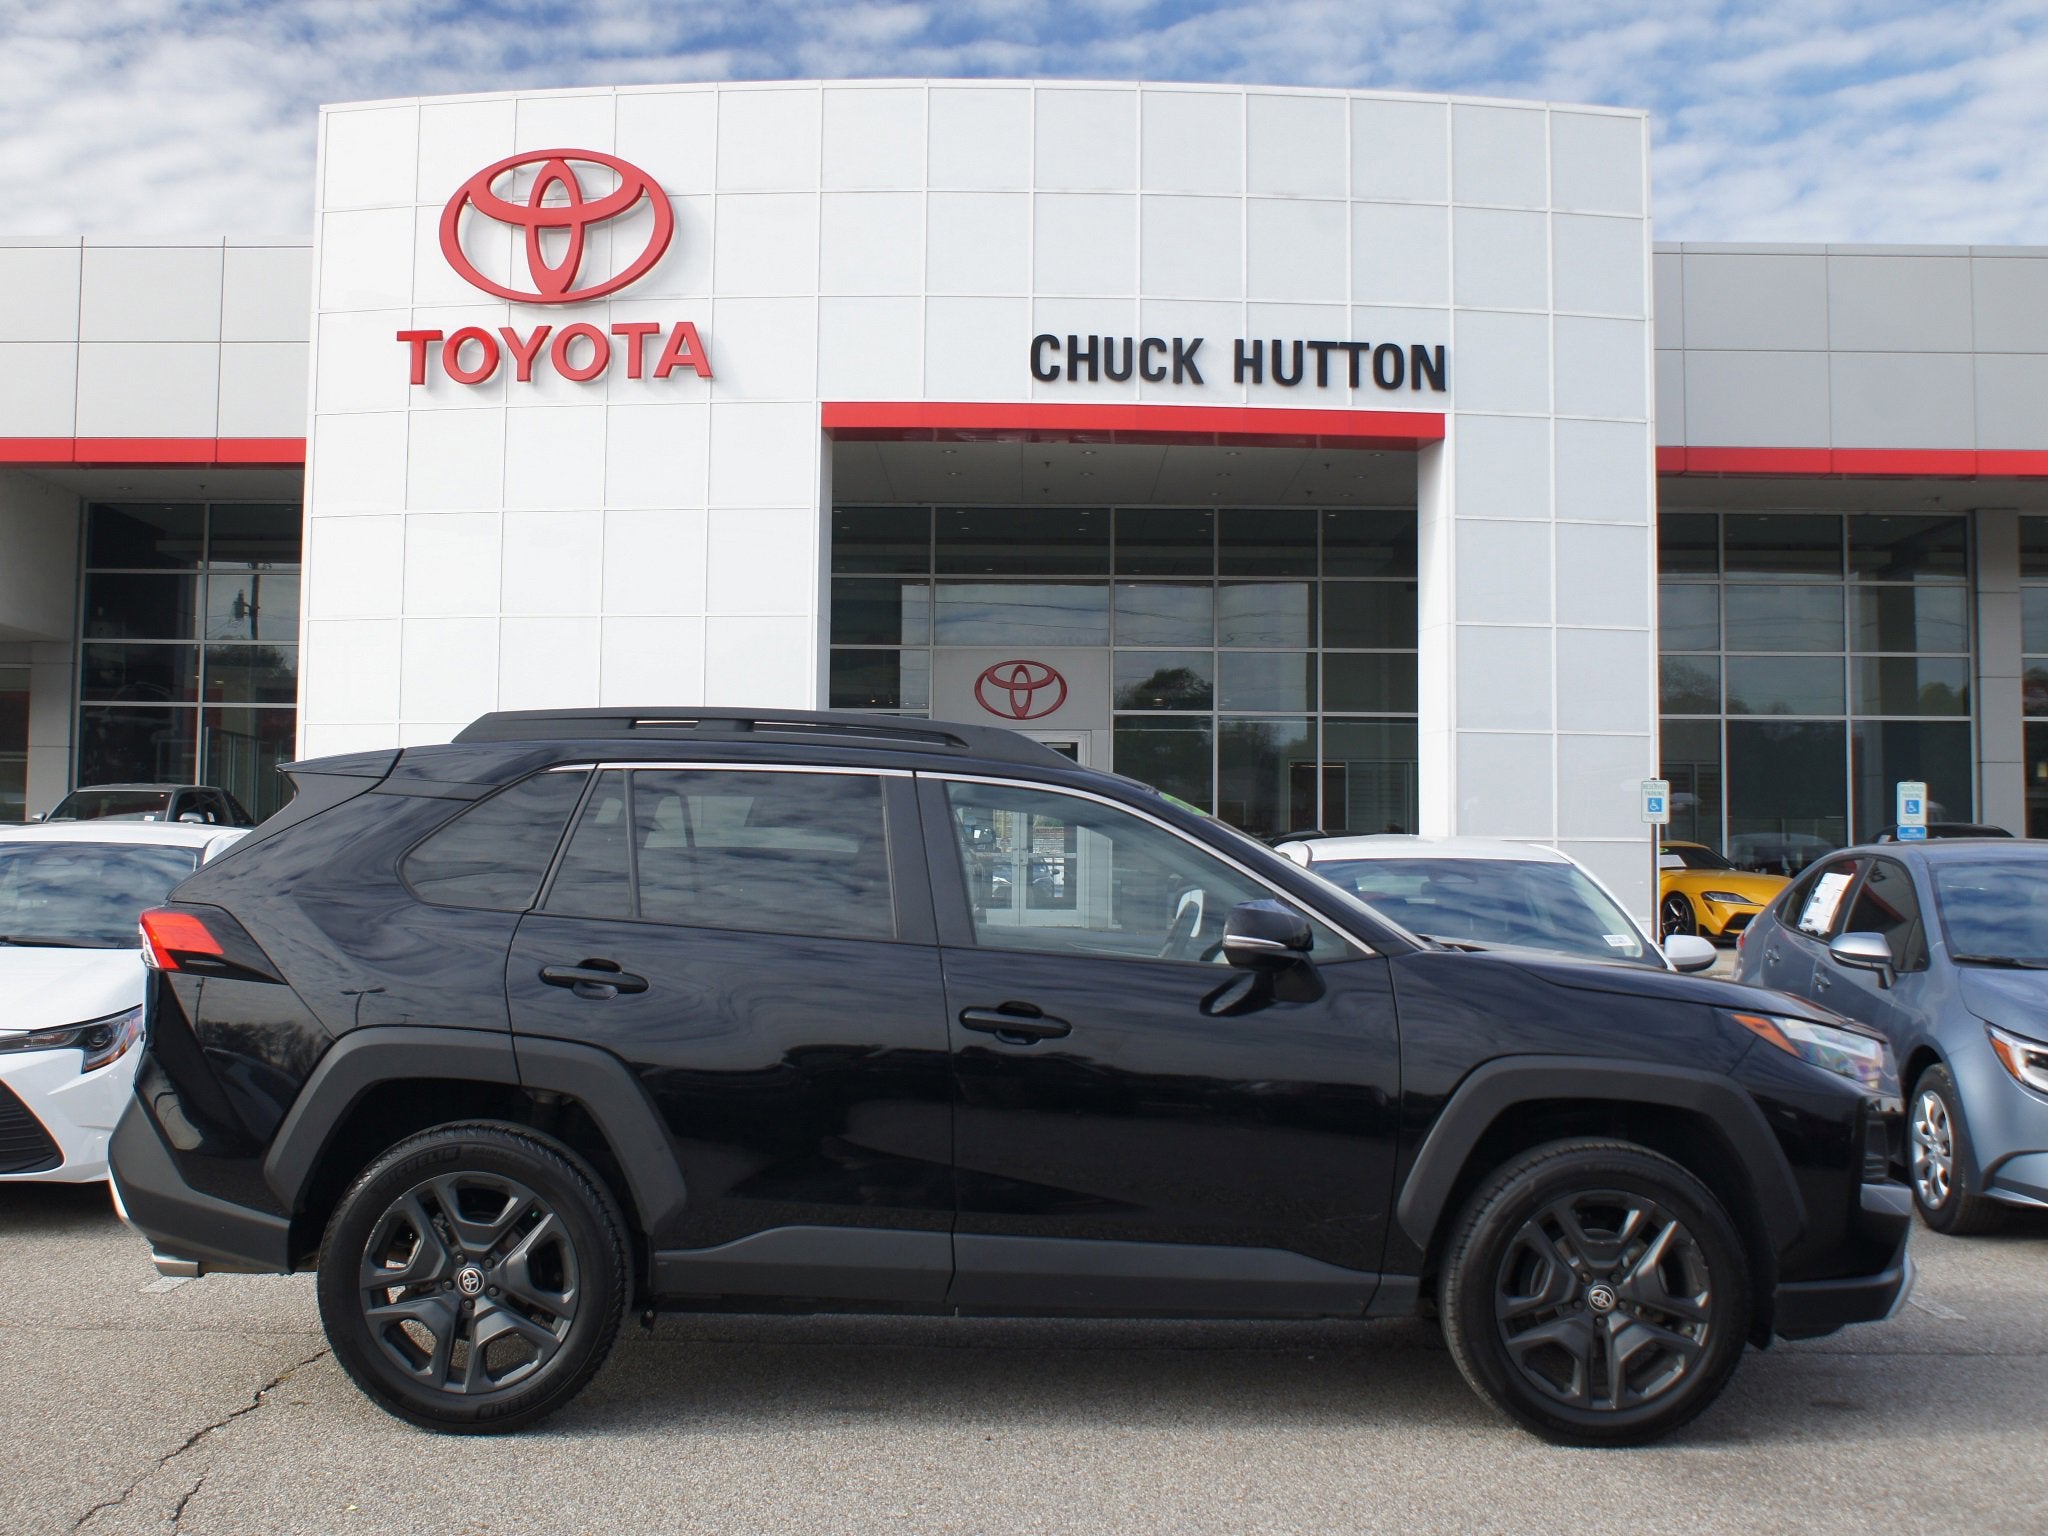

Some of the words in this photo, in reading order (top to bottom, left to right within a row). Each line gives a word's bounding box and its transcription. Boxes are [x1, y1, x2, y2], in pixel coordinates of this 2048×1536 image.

[396, 322, 712, 384] TOYOTA
[1031, 335, 1203, 384] CHUCK
[1235, 339, 1445, 392] HUTTON
